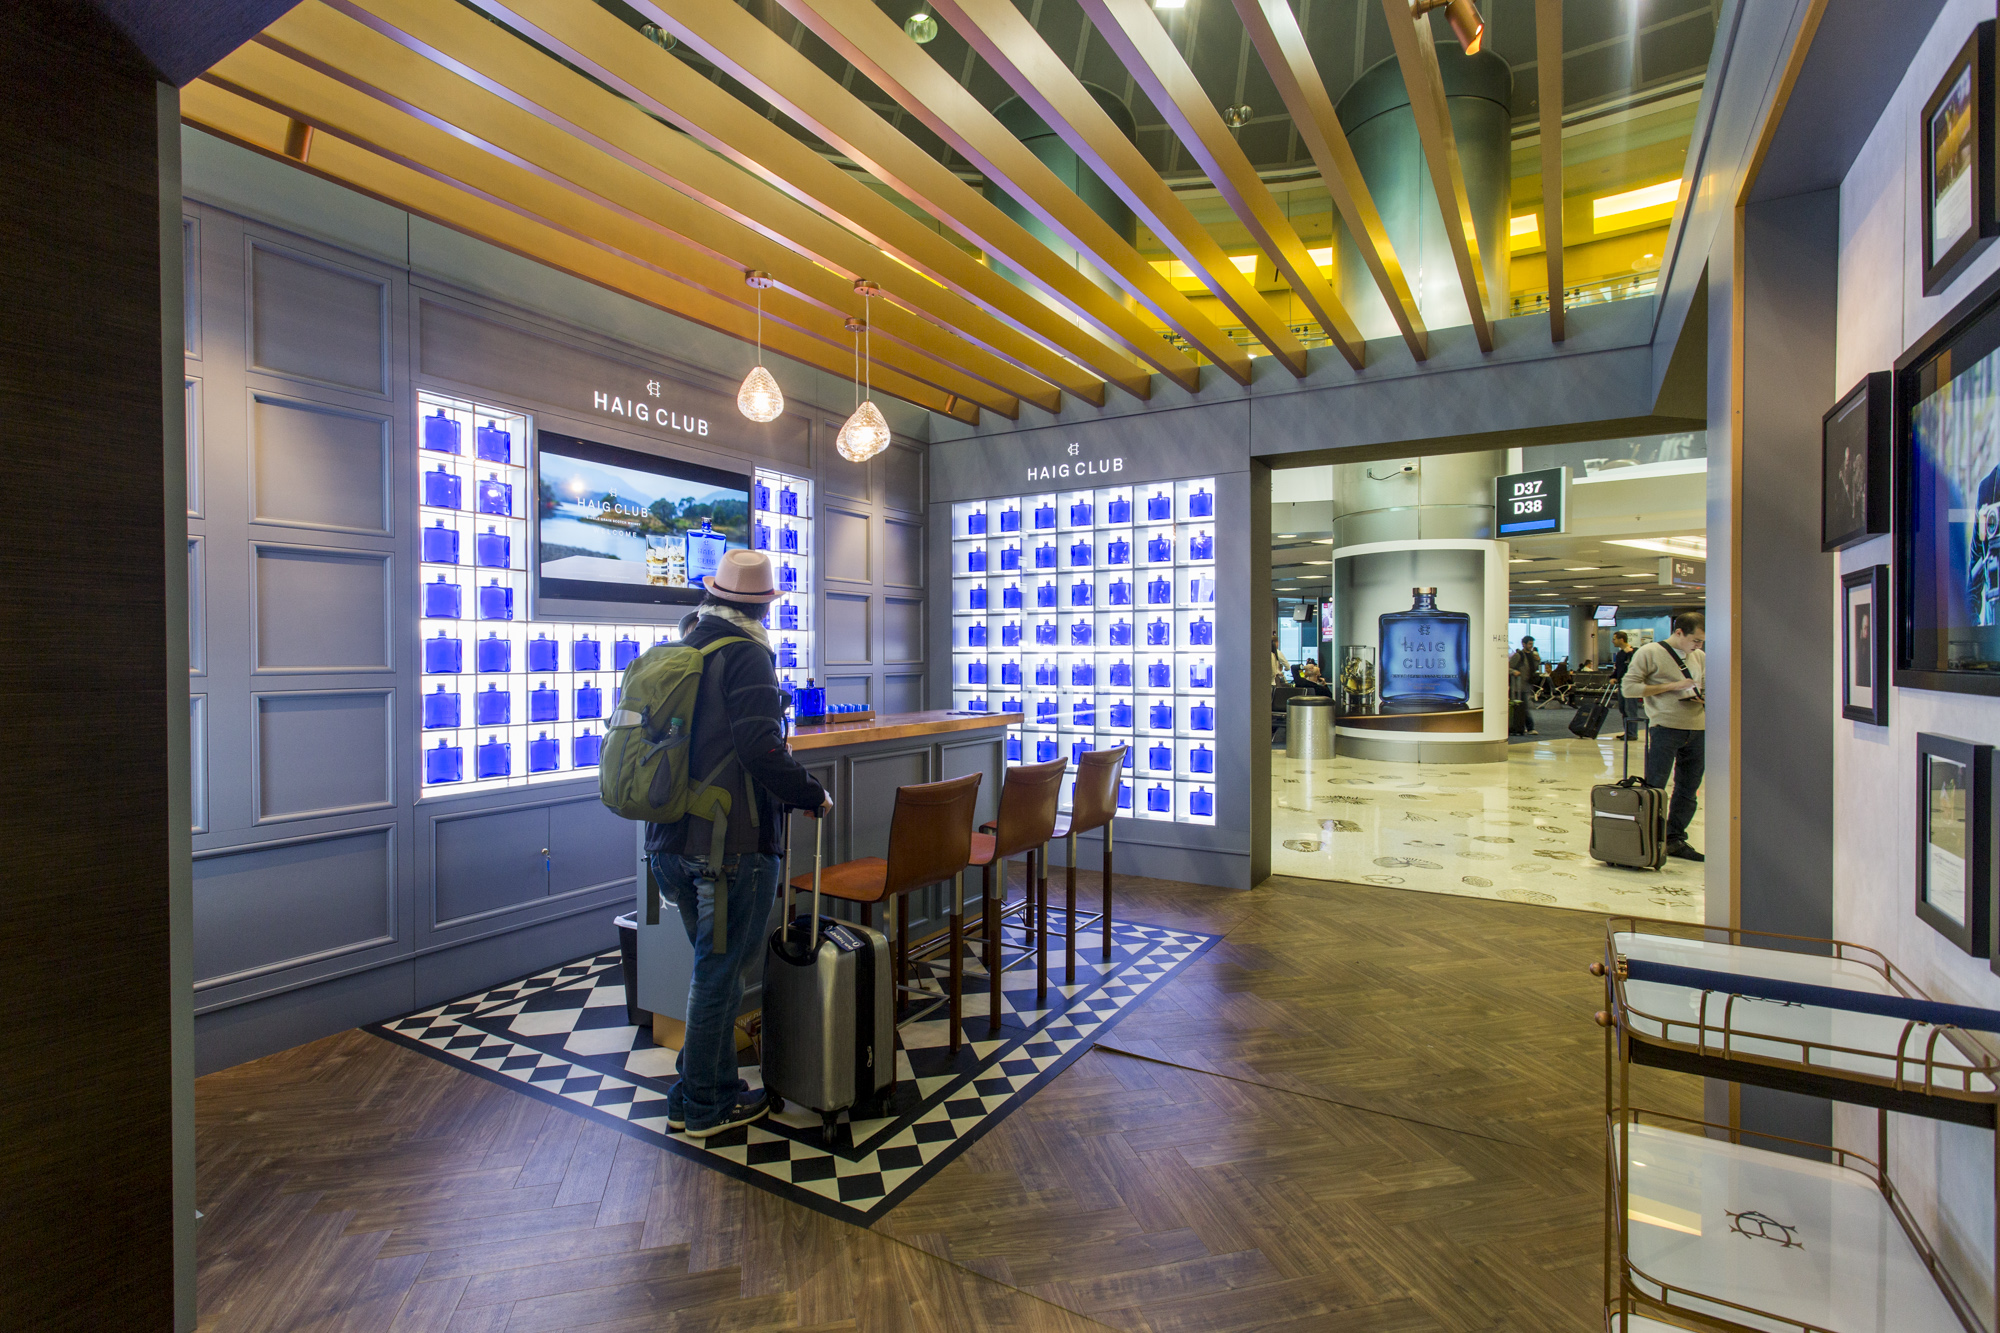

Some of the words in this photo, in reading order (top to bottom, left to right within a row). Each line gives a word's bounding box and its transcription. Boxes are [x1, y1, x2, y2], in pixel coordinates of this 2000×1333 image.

[594, 390, 649, 421] HAIG
[656, 408, 709, 436] CLUB
[1027, 463, 1070, 481] HAIG
[1075, 458, 1123, 476] CLUB
[1513, 480, 1543, 496] D37
[577, 497, 611, 513] HAIG
[614, 503, 648, 518] CLUB
[1513, 499, 1543, 515] D38
[593, 527, 637, 538] WELCOME
[1403, 641, 1446, 653] HAIG
[1402, 658, 1447, 670] CLUB
